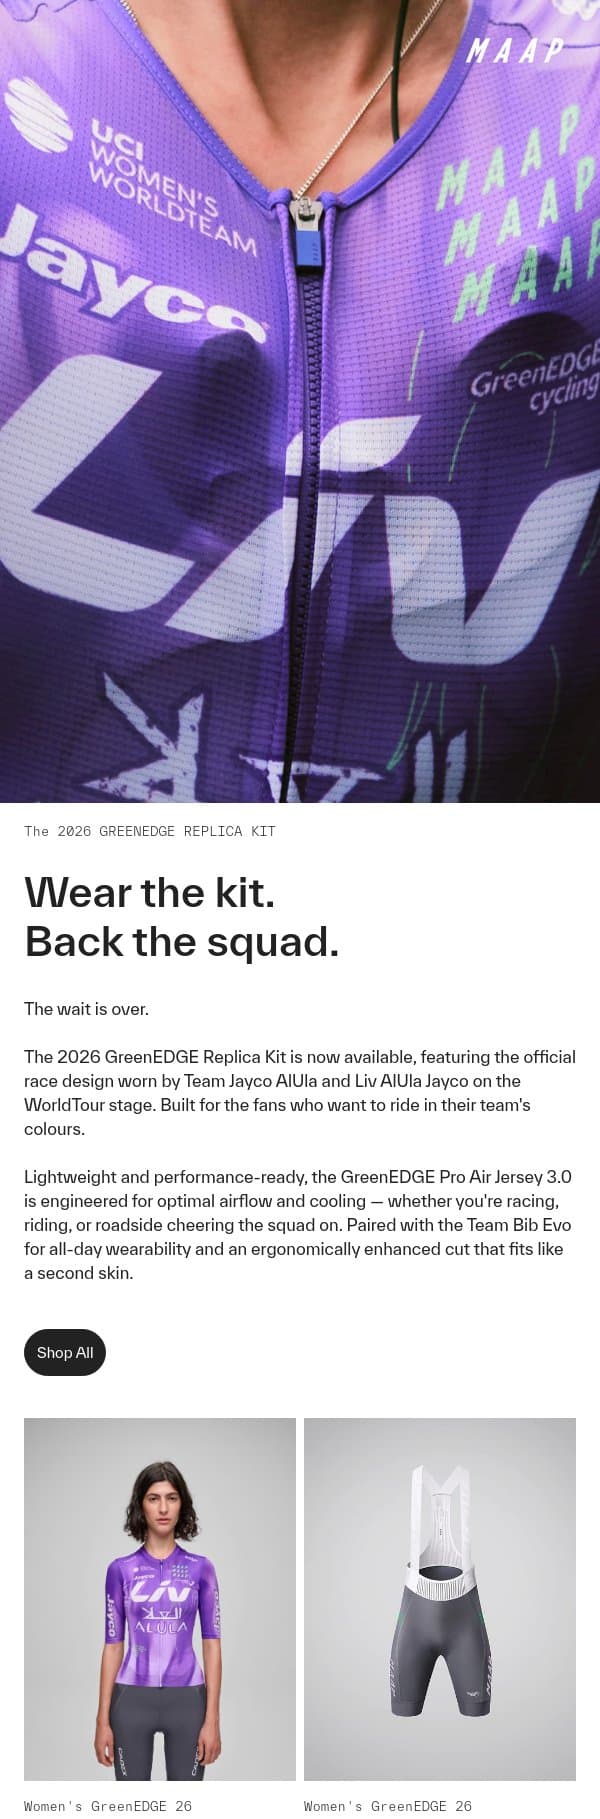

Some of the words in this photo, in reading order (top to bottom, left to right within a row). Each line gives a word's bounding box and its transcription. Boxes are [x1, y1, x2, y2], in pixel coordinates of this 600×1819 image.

[91, 118, 144, 160] UCI
[435, 104, 580, 212] MAAP
[90, 139, 219, 218] WOMEN'S
[88, 161, 258, 257] WORLDTEAM
[444, 155, 595, 267] MAAP
[0, 202, 267, 345] Jayco
[530, 372, 600, 416] cycling
[24, 826, 48, 836] The
[58, 826, 91, 836] 2026
[100, 826, 175, 836] GREENEDGE
[185, 826, 242, 837] REPLICA
[252, 826, 276, 836] KIT
[24, 877, 132, 907] Wear
[140, 877, 204, 907] the
[217, 877, 273, 907] kit.
[27, 926, 124, 956] Back
[132, 926, 196, 956] the
[208, 926, 338, 964] squad.
[24, 1270, 32, 1279] a
[38, 1266, 93, 1280] second
[99, 1265, 133, 1279] skin.
[37, 1347, 72, 1361] Shop
[76, 1347, 93, 1359] All
[130, 1580, 192, 1602] Liv
[135, 1621, 188, 1633] ALULA
[24, 1801, 81, 1812] Women's
[92, 1801, 166, 1811] GreenEDGE
[176, 1801, 191, 1811] 26
[304, 1801, 361, 1812] Women's
[372, 1801, 446, 1811] GreenEDGE
[456, 1801, 471, 1811] 26
